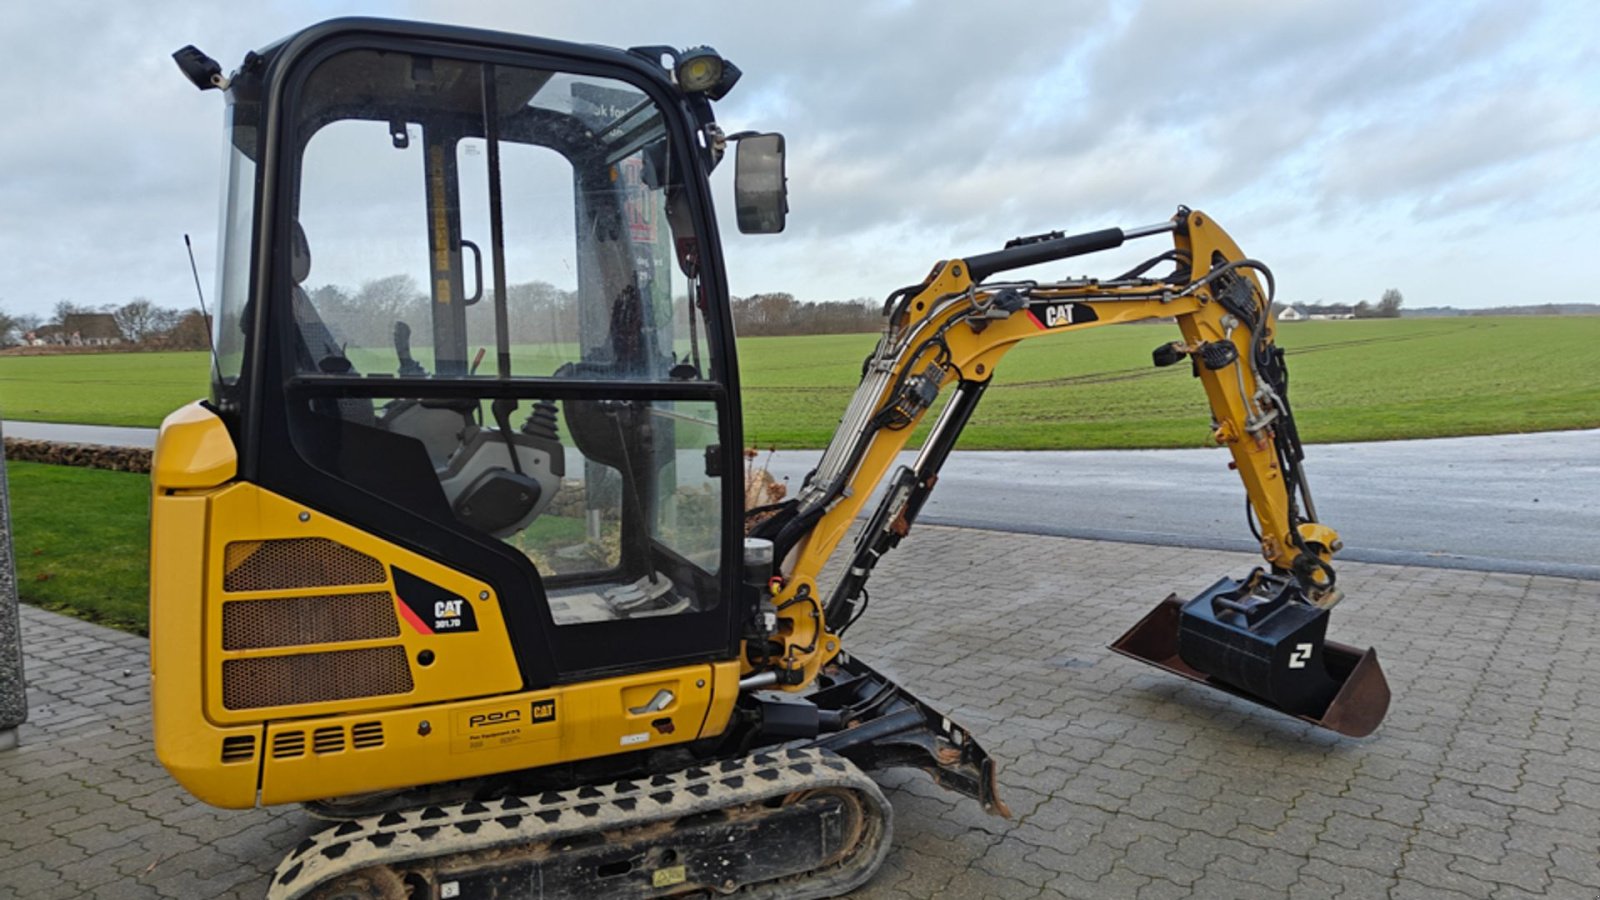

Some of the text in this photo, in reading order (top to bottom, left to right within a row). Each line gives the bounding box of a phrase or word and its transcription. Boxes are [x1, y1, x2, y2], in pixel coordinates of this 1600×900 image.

[1046, 304, 1074, 327] CAT
[434, 599, 463, 618] CAT
[533, 704, 554, 718] CAT
